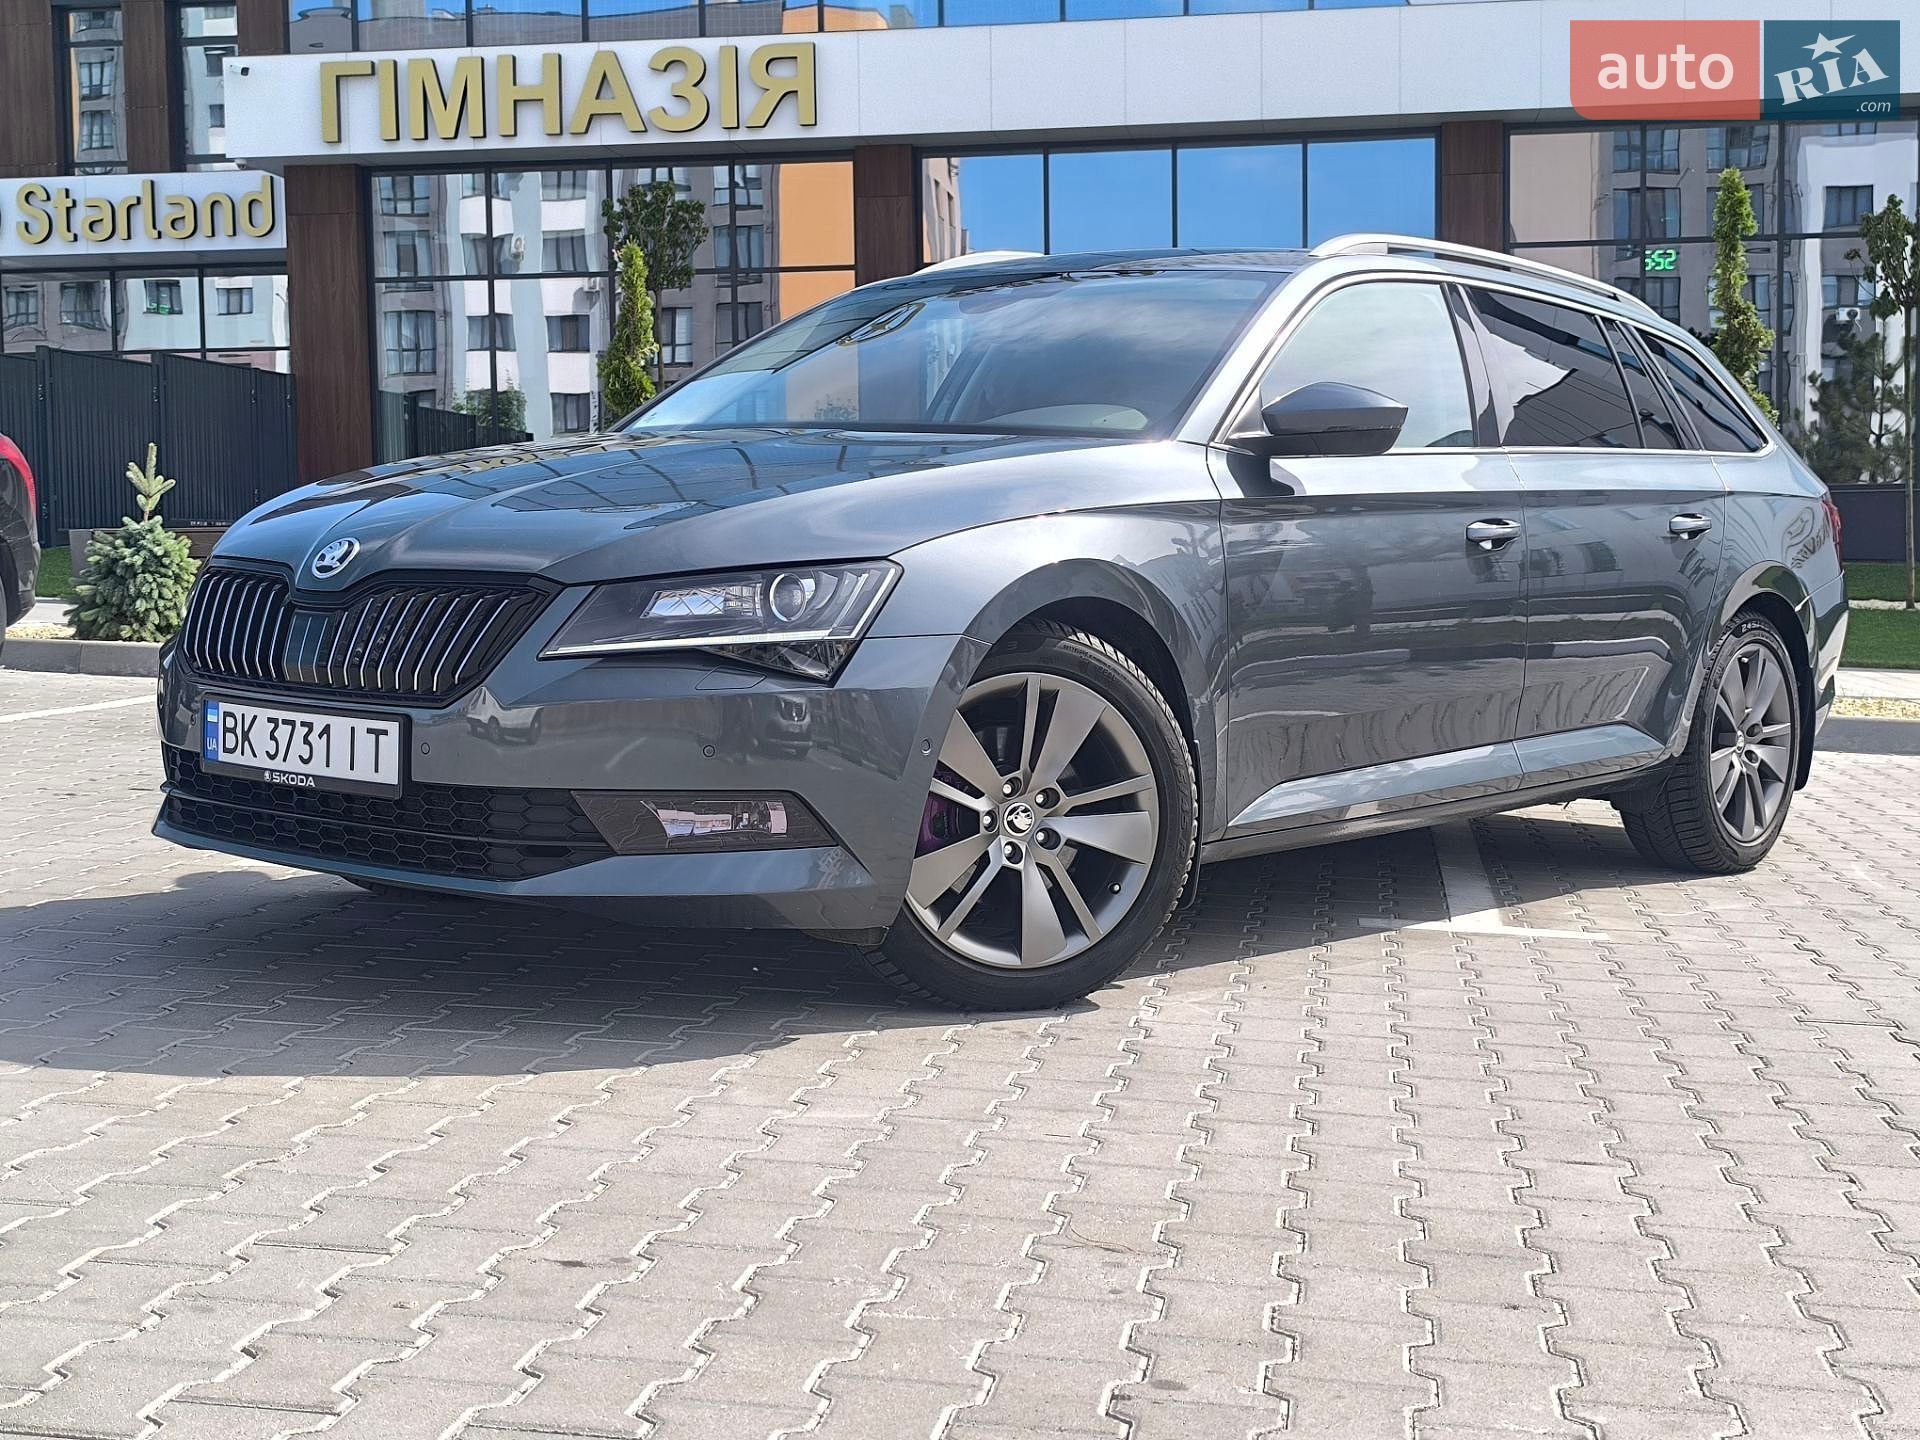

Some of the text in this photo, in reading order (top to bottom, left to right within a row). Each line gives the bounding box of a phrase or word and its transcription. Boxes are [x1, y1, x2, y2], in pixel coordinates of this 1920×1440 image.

[320, 41, 816, 143] ГІМНАЗІЯ
[15, 175, 274, 244] Starland
[206, 737, 218, 751] UA
[222, 710, 389, 774] BK 3731 IT
[271, 771, 316, 788] SKODA
